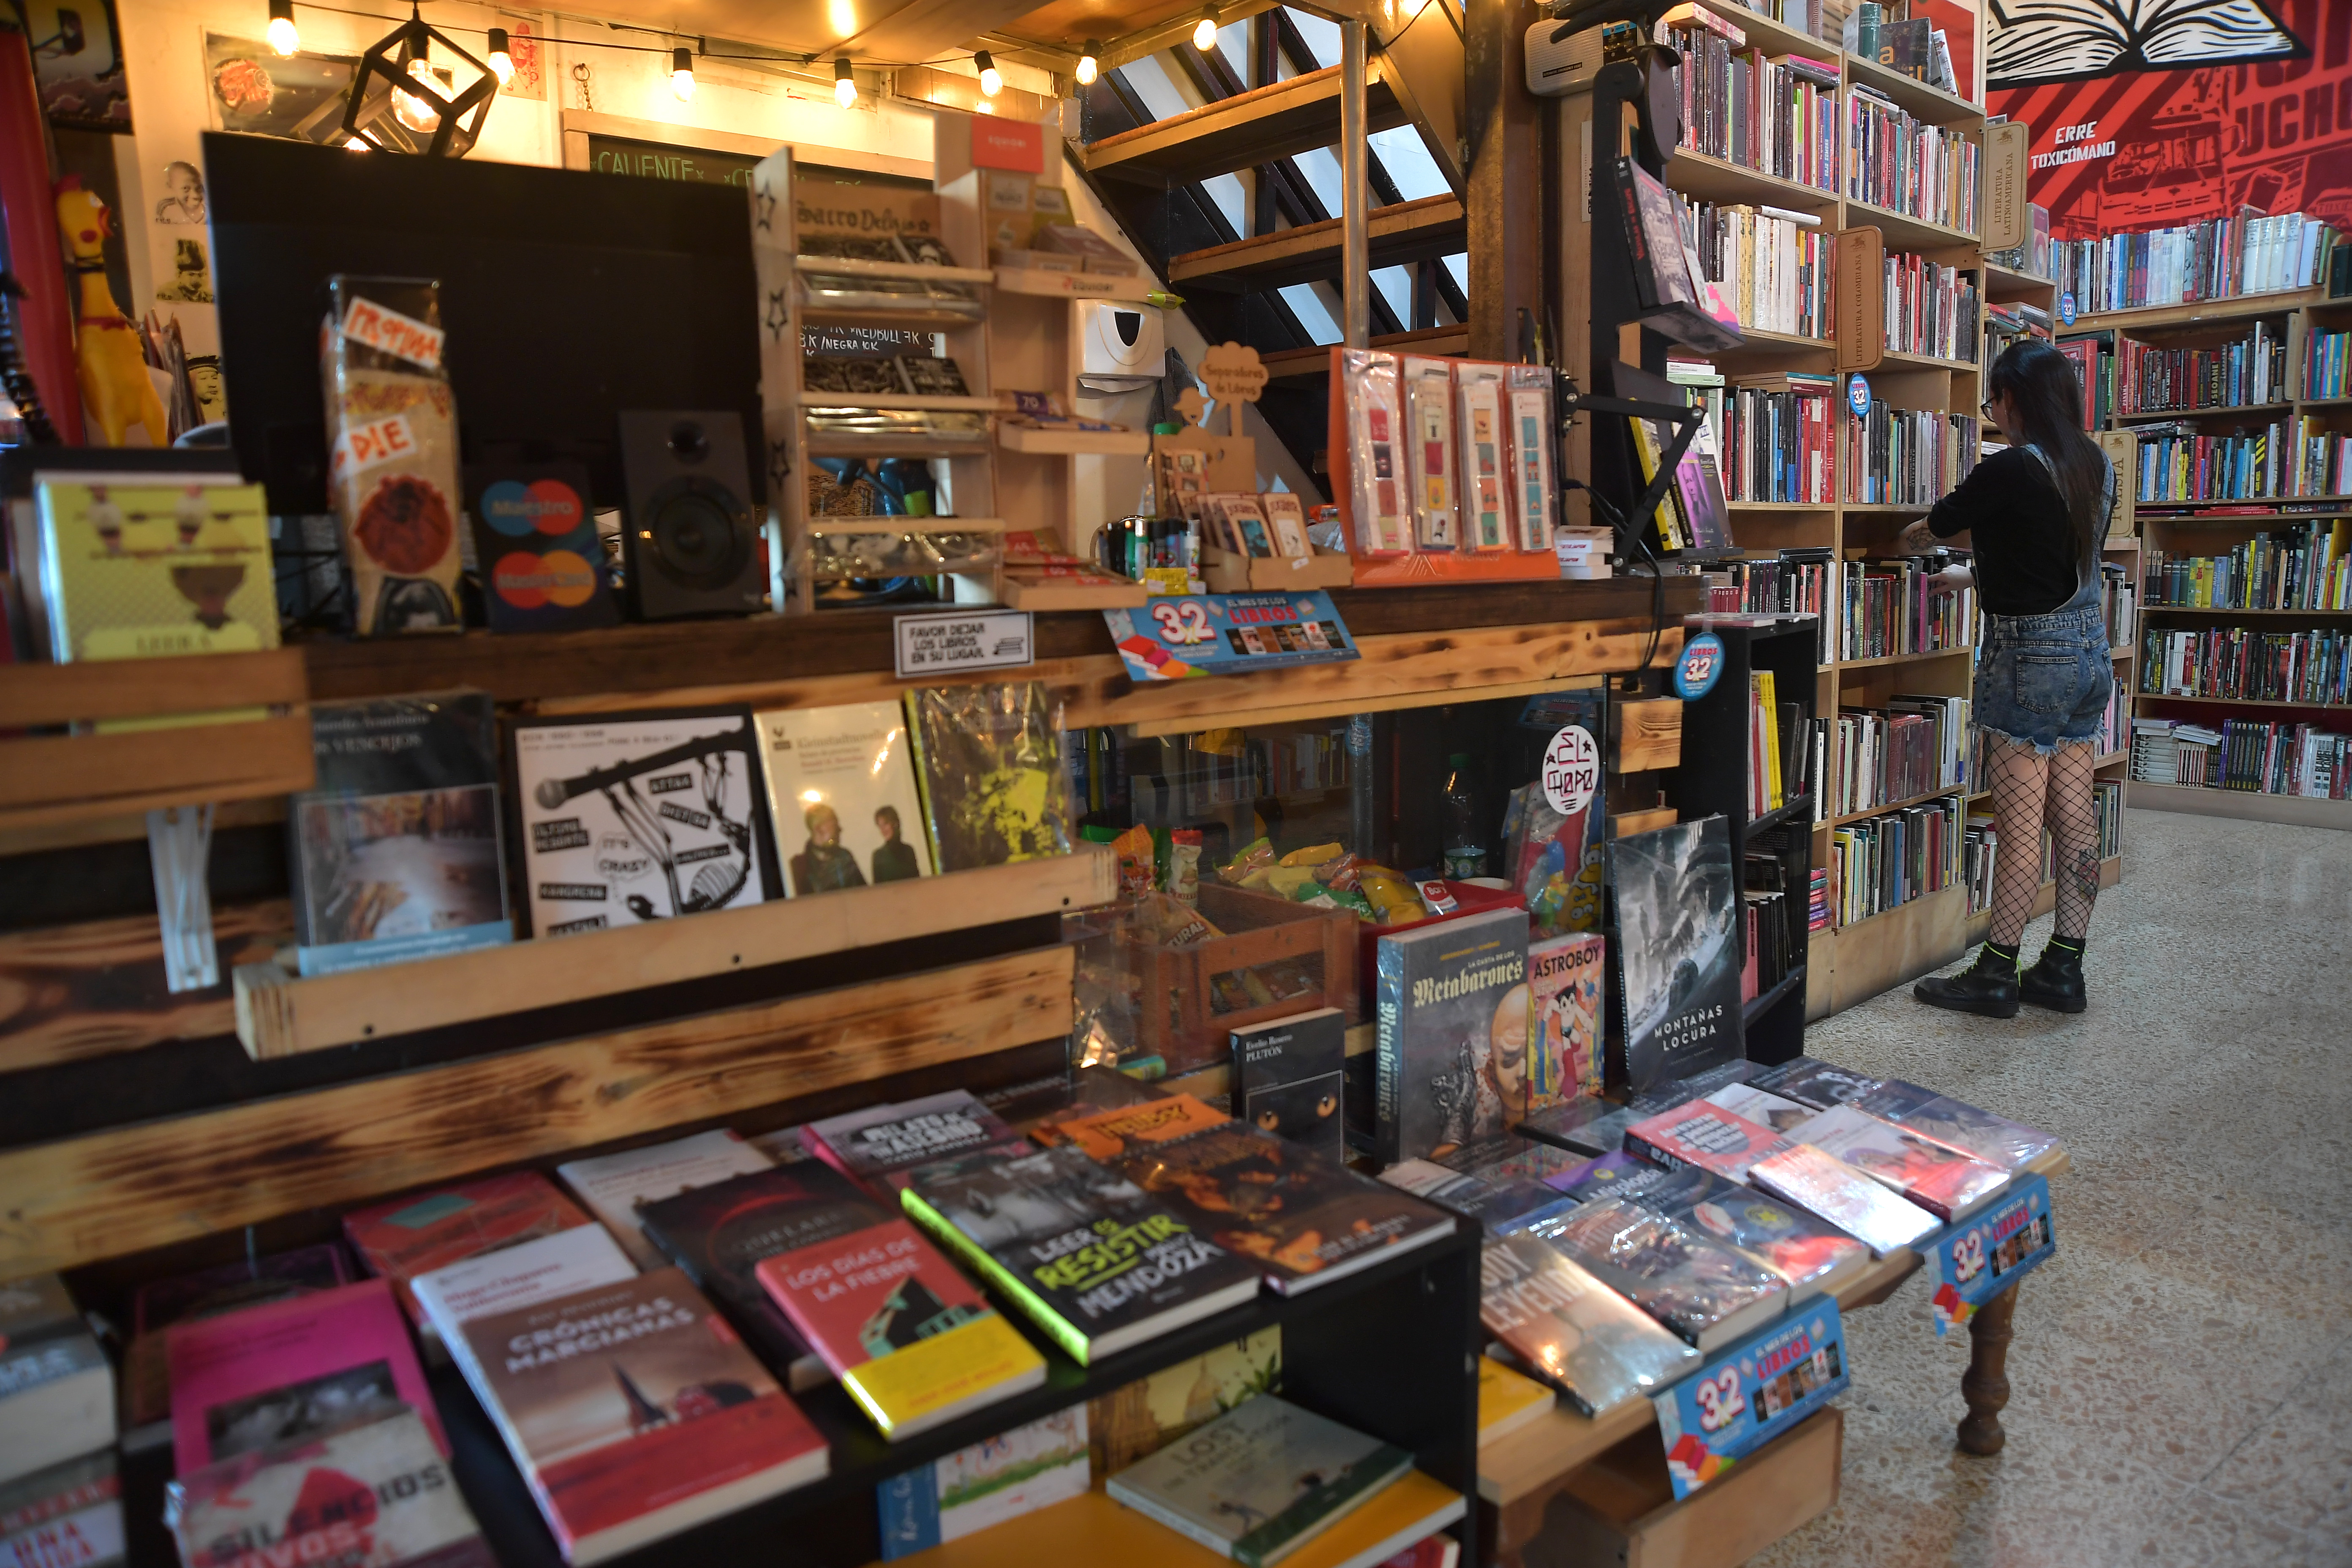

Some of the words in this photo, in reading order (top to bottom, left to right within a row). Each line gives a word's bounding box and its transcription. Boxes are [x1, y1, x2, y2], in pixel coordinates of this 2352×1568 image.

[2055, 121, 2097, 144] ERRE
[597, 151, 694, 180] CALIENTE
[2031, 140, 2115, 169] TOXICÓMANO
[2004, 152, 2013, 236] LATINOAMERICANA
[1206, 364, 1264, 379] Separadores
[2211, 364, 2219, 399] SEOANE
[2111, 457, 2123, 521] POESÍA
[909, 626, 945, 639] FAVOR
[950, 623, 985, 636] DEJAR
[1228, 605, 1298, 623] LIBROS
[911, 650, 927, 664] EN
[930, 649, 944, 662] SU
[914, 638, 934, 651] LOS
[938, 635, 977, 649] LIBROS
[1690, 648, 1718, 656] LIBROS
[1533, 945, 1601, 980] ASTROBOY
[1412, 956, 1524, 1009] Metabarones
[1654, 1004, 1724, 1039] MONTAÑAS
[1662, 1025, 1718, 1052] LOCURA
[1245, 1044, 1283, 1063] PLUTÓN
[1993, 1206, 2029, 1241] LIBROS
[1029, 1227, 1103, 1263] LEER
[1033, 1214, 1191, 1291] RESISTIR
[785, 1263, 833, 1290] LOS
[832, 1247, 886, 1274] DÍAS
[886, 1236, 920, 1258] DE
[812, 1281, 847, 1303] LA
[846, 1254, 924, 1290] FIEBRE
[1076, 1239, 1225, 1317] MENDOZA
[1481, 1263, 1592, 1334] LEYEND
[505, 1308, 695, 1373] MARCIANAS
[508, 1296, 673, 1353] CRÓNICAS
[1756, 1334, 1812, 1380] LIBROS
[1168, 1414, 1252, 1466] LOST
[208, 1463, 446, 1557] SILENCIOS
